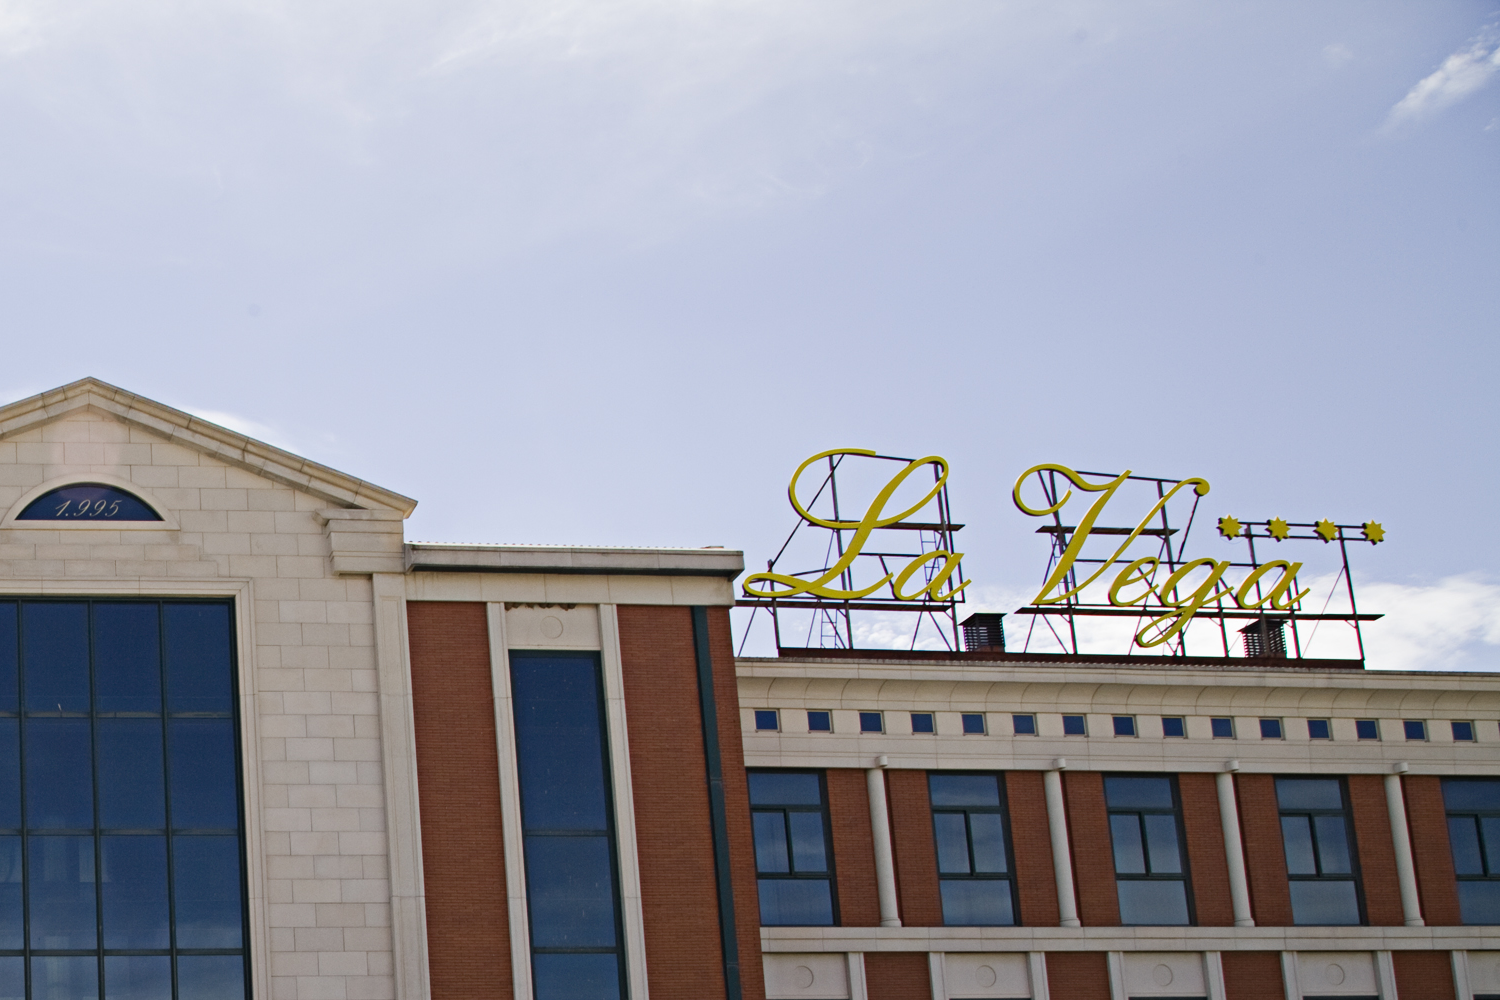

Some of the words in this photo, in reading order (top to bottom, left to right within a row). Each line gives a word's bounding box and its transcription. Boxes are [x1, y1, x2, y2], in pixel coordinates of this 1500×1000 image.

[55, 499, 122, 517] 1.995
[742, 447, 973, 602] La
[1011, 462, 1312, 649] Vega
